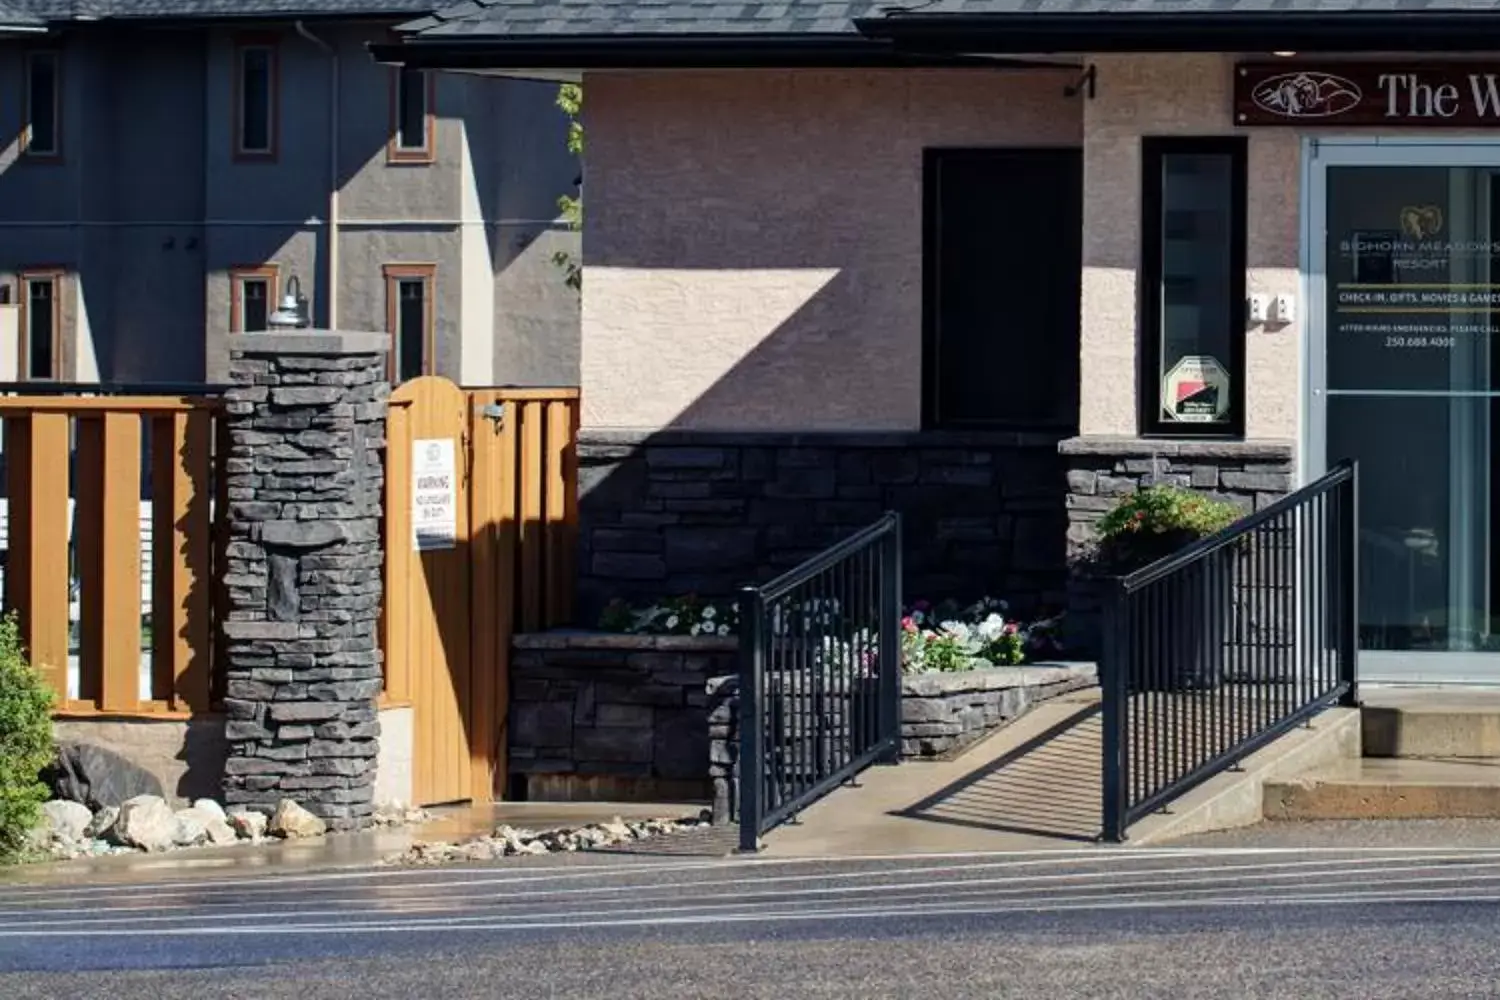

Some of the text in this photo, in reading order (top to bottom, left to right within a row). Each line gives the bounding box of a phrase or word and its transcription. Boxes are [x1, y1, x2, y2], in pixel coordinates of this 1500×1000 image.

[1378, 73, 1459, 118] The
[1340, 240, 1414, 251] BIGHORN
[1393, 259, 1448, 269] RESORT
